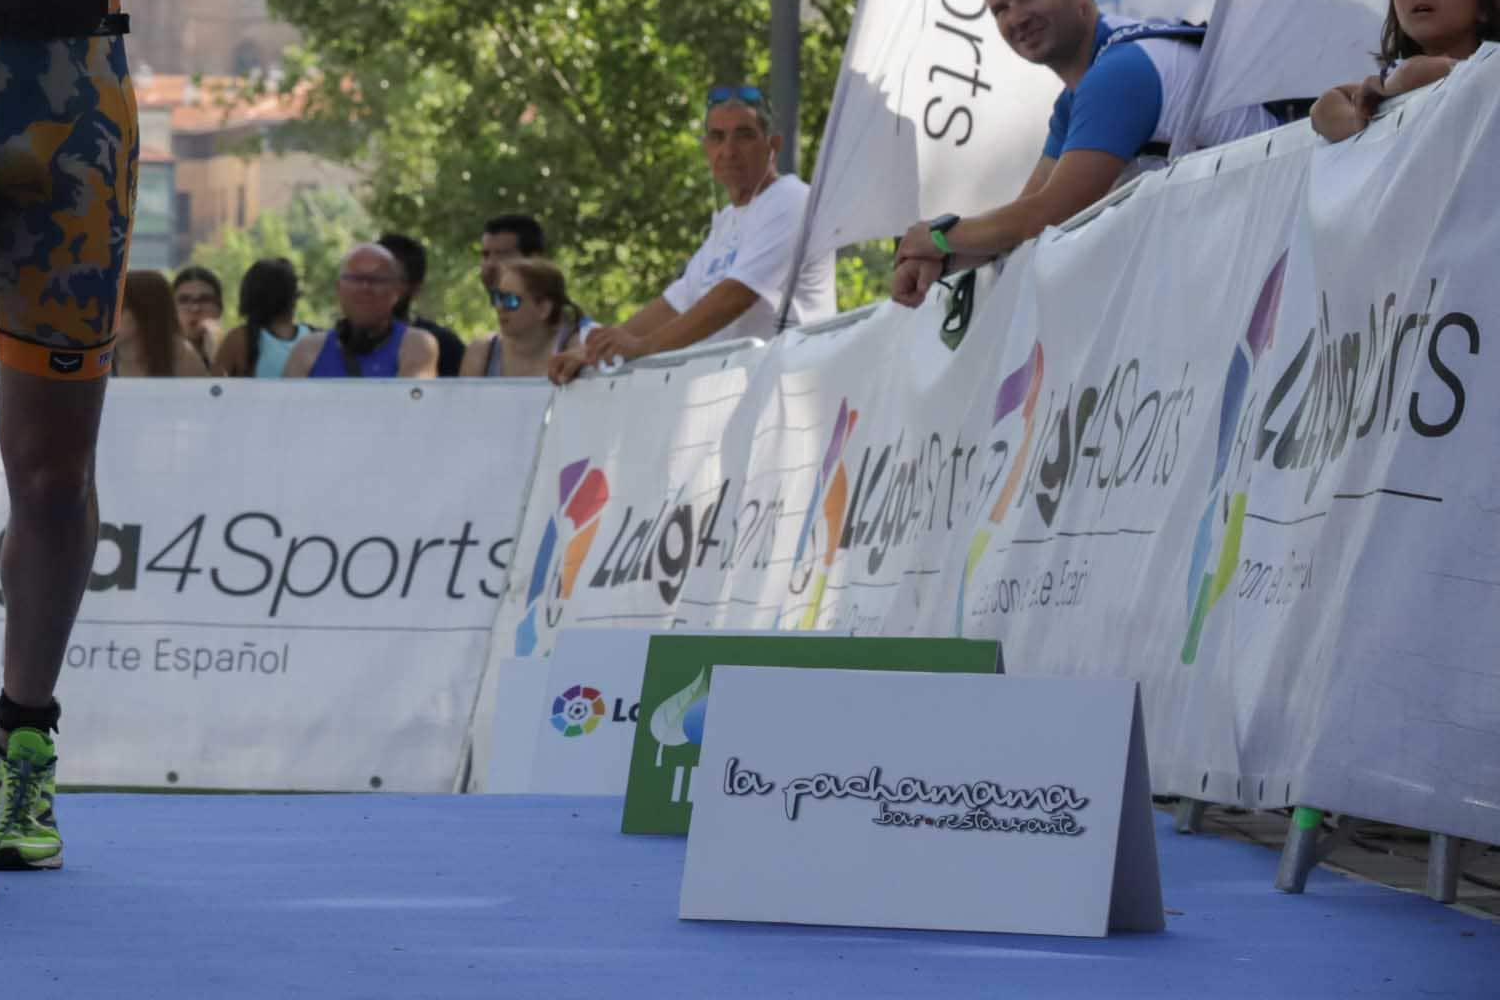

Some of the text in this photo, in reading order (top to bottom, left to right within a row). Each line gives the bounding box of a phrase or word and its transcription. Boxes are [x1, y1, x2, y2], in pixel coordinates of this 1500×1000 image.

[154, 637, 289, 679] Español
[723, 757, 774, 797] la
[783, 766, 1090, 820] pachamama
